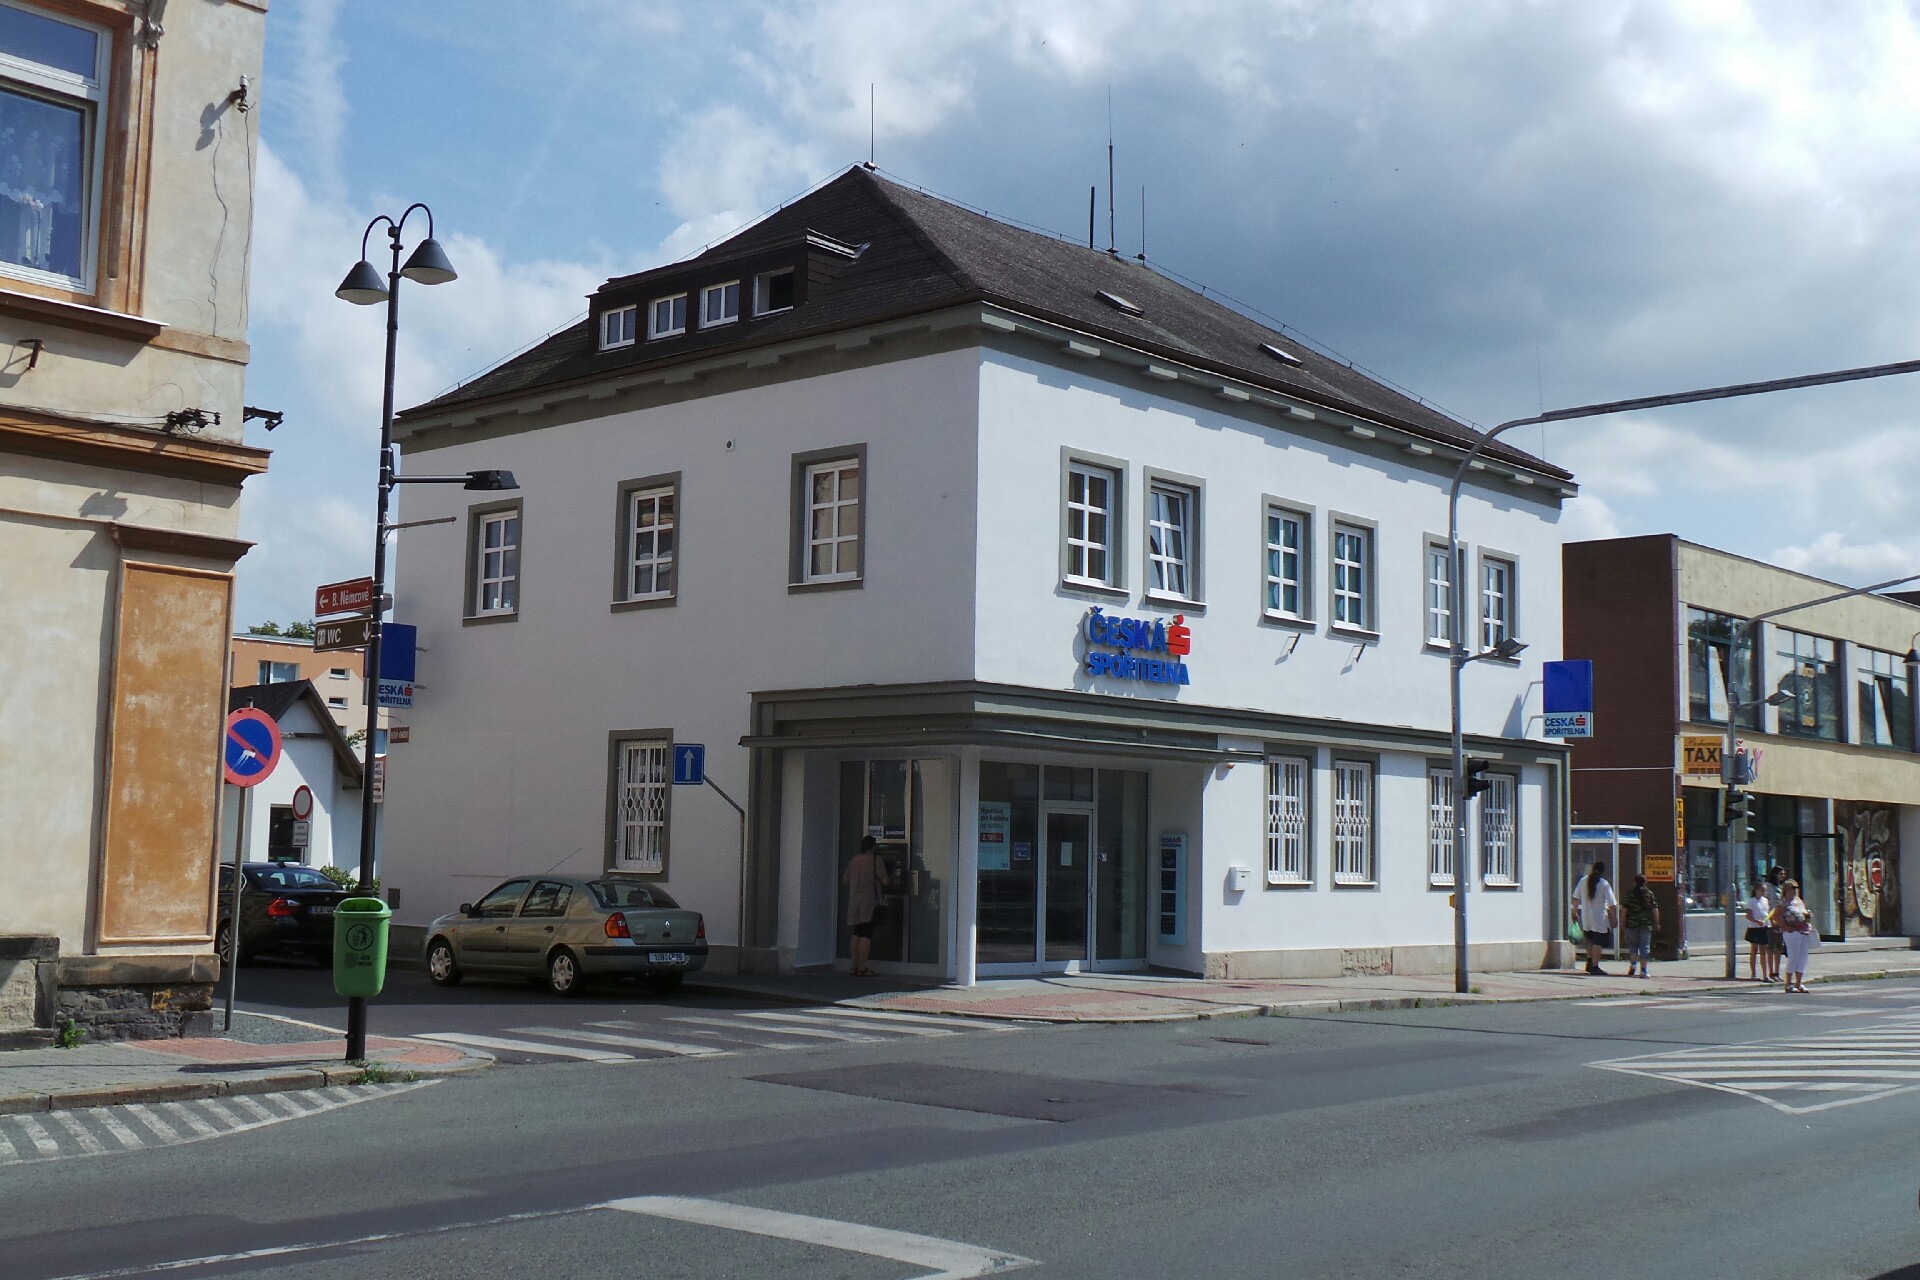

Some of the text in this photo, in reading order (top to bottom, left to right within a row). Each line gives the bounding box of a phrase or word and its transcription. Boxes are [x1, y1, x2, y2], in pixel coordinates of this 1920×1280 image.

[332, 586, 369, 607] B. Němcové
[327, 628, 342, 644] WC
[1090, 606, 1166, 652] ČESKÁ
[1088, 651, 1190, 685] SPOŘITELNA
[379, 684, 404, 696] ESKÁ
[378, 696, 412, 706] OŘITELNA
[1544, 716, 1576, 727] ČESKÁ
[1544, 727, 1586, 736] SPOŘITELNA
[1684, 747, 1722, 763] TAXI
